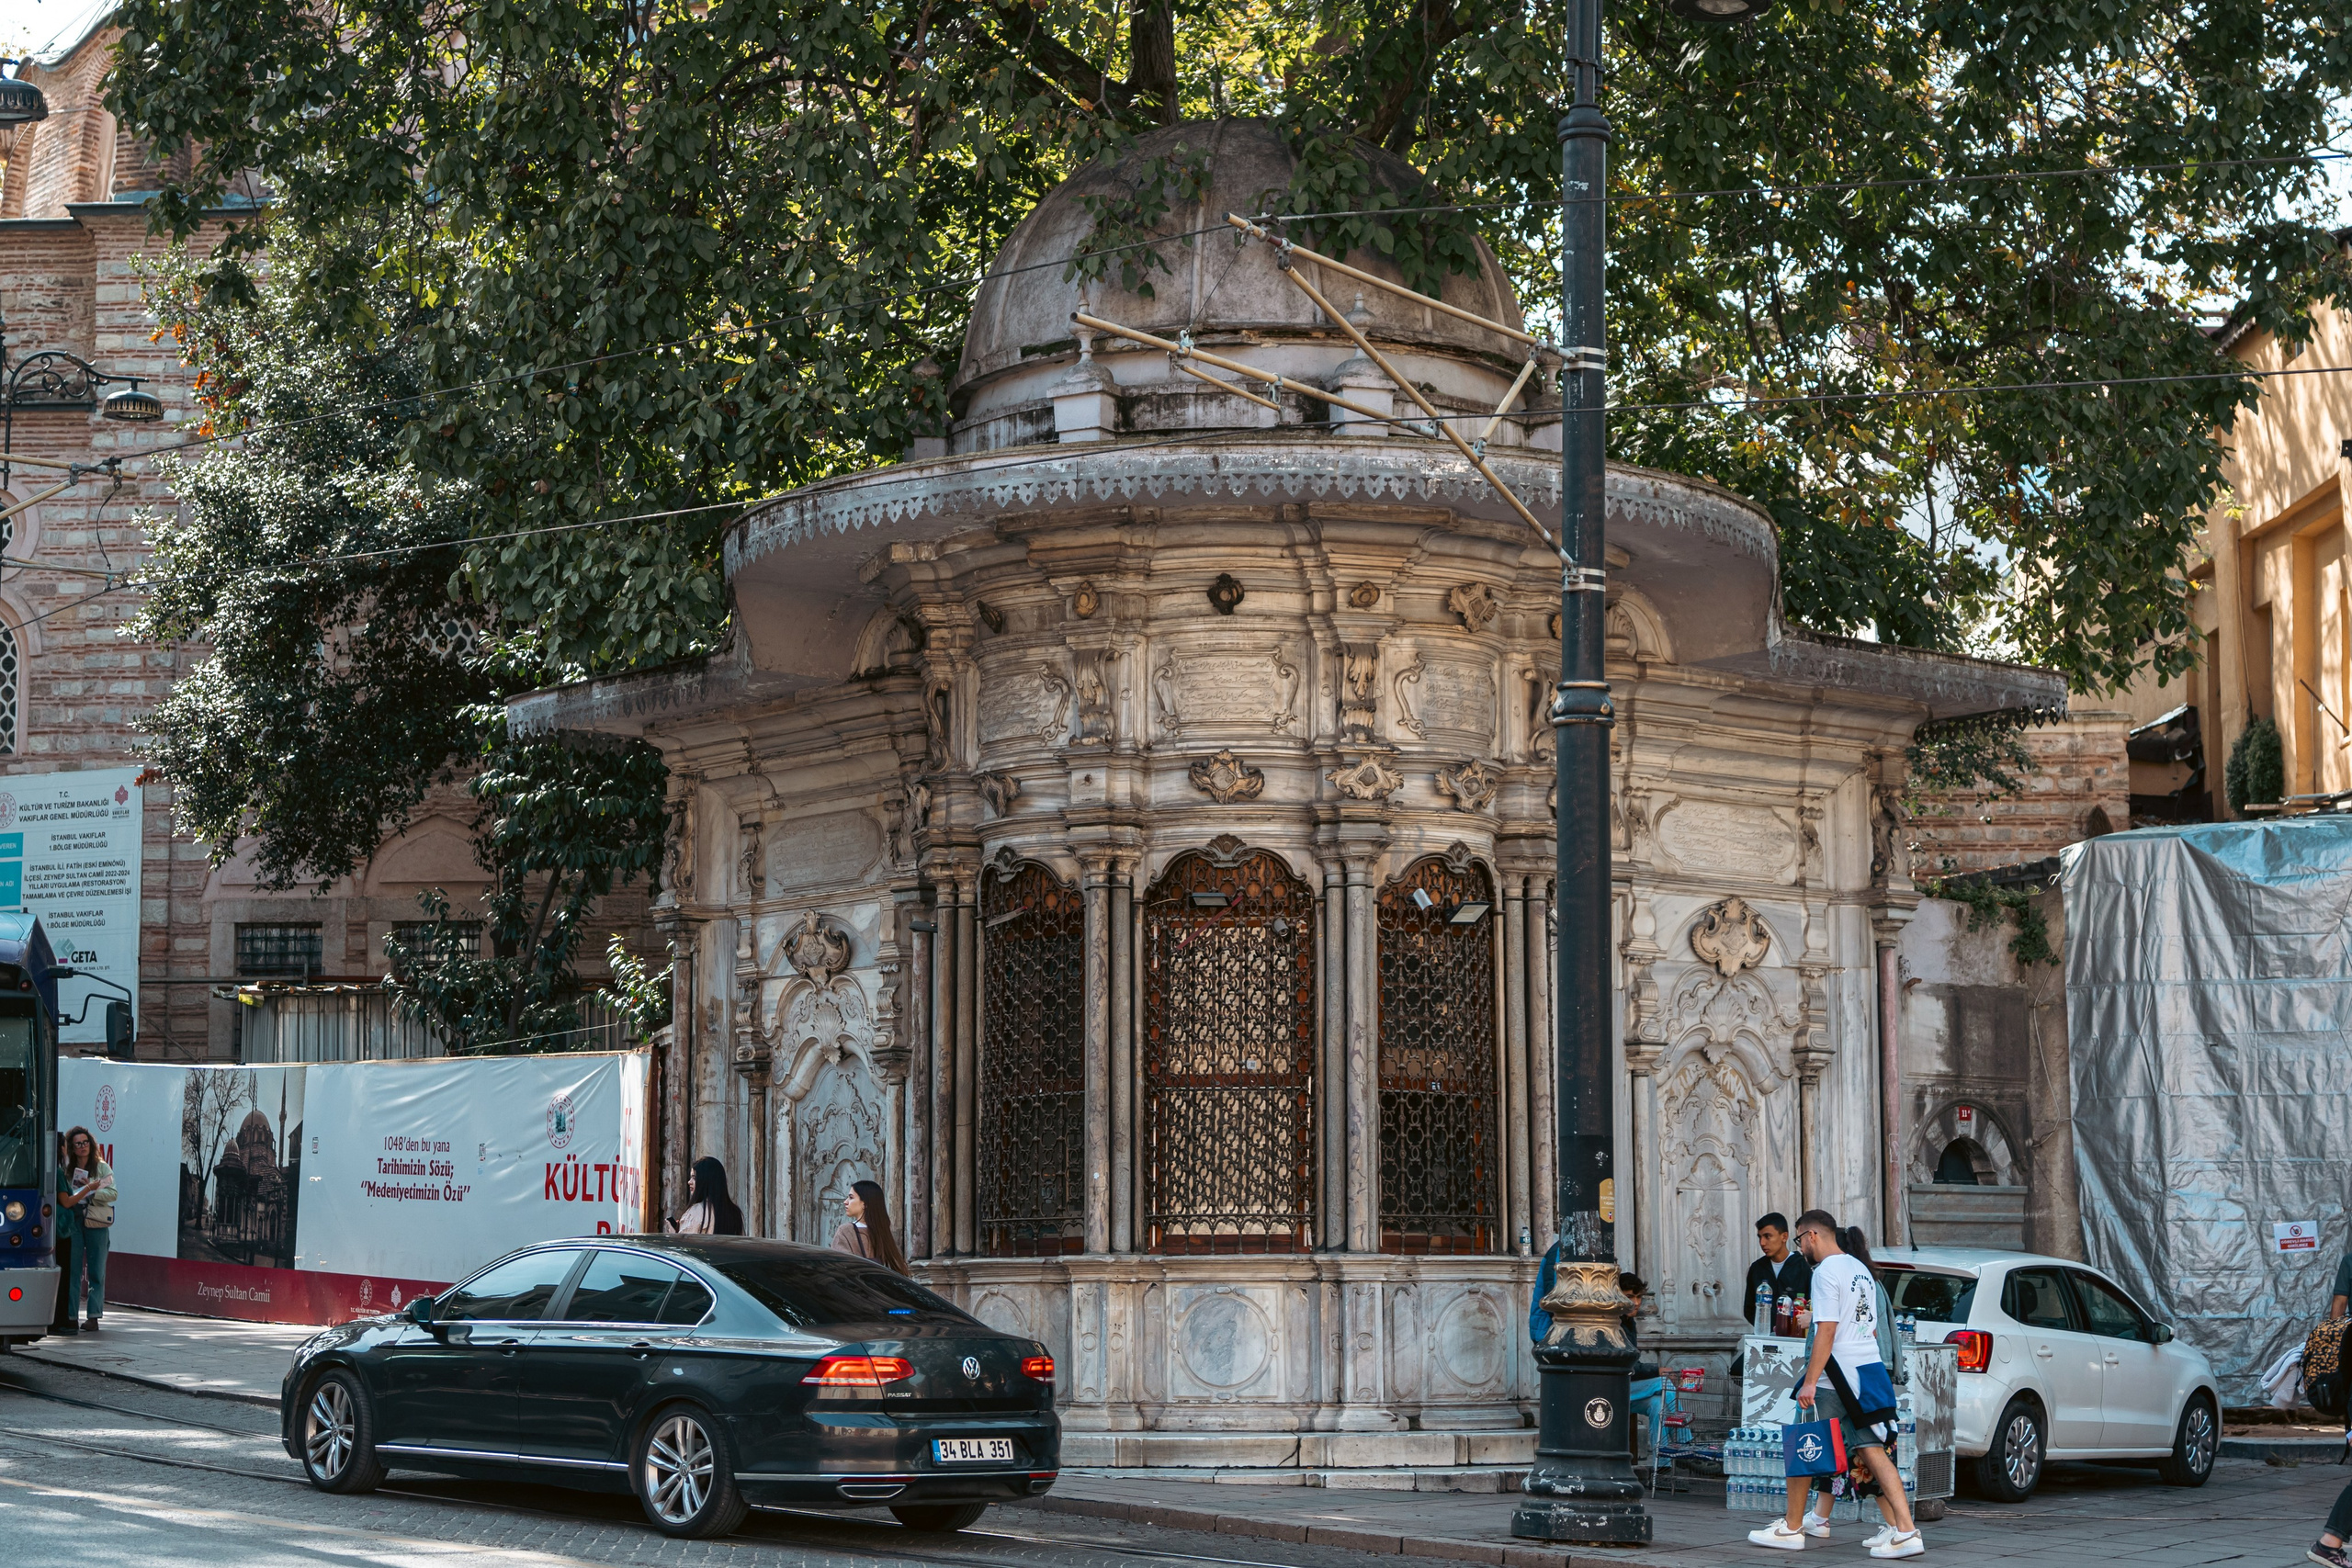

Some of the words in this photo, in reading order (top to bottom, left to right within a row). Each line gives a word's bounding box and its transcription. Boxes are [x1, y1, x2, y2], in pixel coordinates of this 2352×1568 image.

[54, 800, 74, 808] TURİZM
[76, 797, 109, 807] BAKANLIĞI
[19, 813, 48, 822] VAKIFLAR
[70, 809, 108, 819] MÜDÜRLÜĞÜ
[51, 833, 77, 841] İSTANBUL
[79, 831, 106, 840] VAKIFLAR
[73, 840, 108, 850] MÜDÜRLÜĞÜ
[29, 863, 56, 872] İSTANBUL
[65, 862, 83, 870] FATİH
[83, 861, 98, 870] (ESKİ
[98, 859, 126, 867] EMİNÖNÜ)
[43, 873, 65, 881] ZEYNEP
[65, 871, 87, 879] SULTAN
[88, 870, 104, 878] CAMİİ
[50, 881, 80, 889] UYGULAMA
[81, 878, 126, 888] (RESTORASYON)
[22, 892, 57, 900] TAMAMLAMA
[65, 889, 85, 899] ÇEVRE
[85, 886, 124, 897] DÜZENLEMESİ
[48, 911, 75, 919] İSTANBUL
[76, 909, 104, 918] VAKIFLAR
[70, 919, 106, 928] MÜDÜRLÜĞÜ
[71, 951, 97, 964] GETA
[384, 1136, 419, 1152] 1048'den
[421, 1137, 430, 1152] bu
[433, 1141, 450, 1155] yana
[378, 1157, 425, 1176] Tarihimizin
[429, 1159, 454, 1179] Sözü;
[198, 1281, 223, 1302] Zeynep
[225, 1284, 247, 1301] Sultan
[248, 1287, 270, 1303] Camii
[941, 1441, 956, 1459] 34
[959, 1440, 984, 1459] BLA
[989, 1440, 1011, 1458] 351
